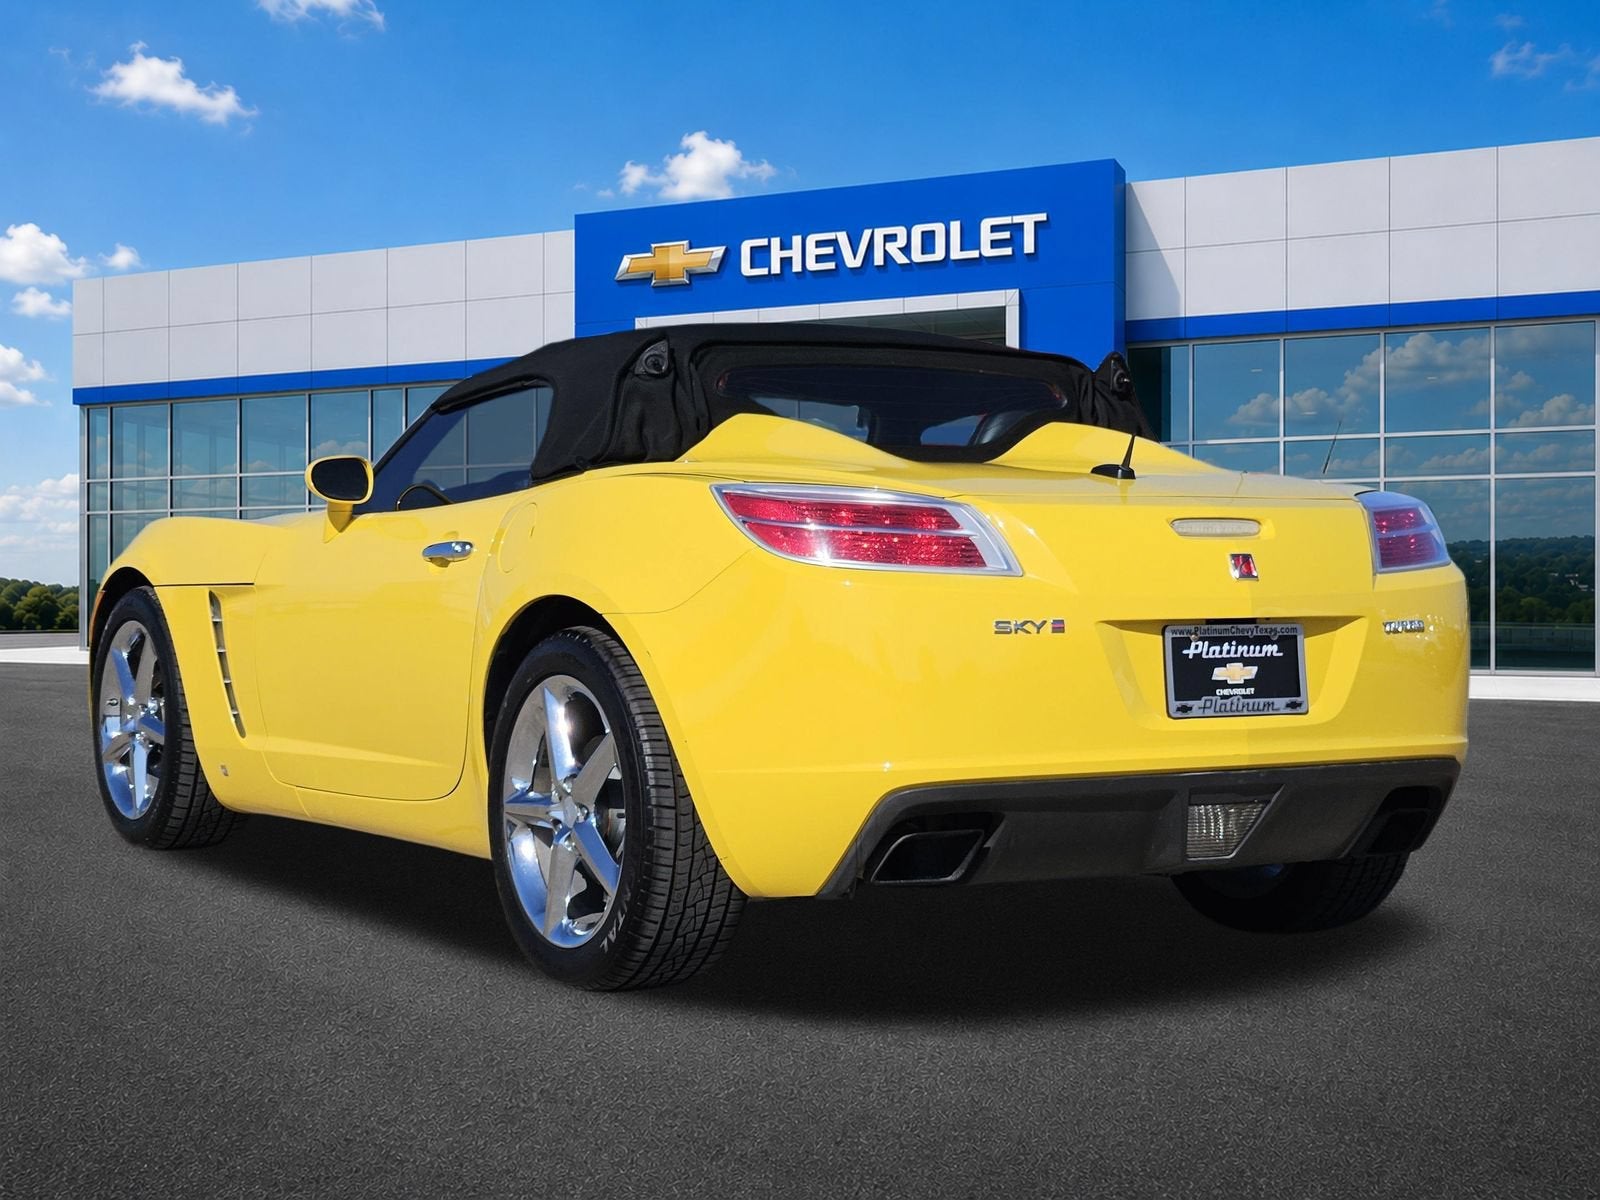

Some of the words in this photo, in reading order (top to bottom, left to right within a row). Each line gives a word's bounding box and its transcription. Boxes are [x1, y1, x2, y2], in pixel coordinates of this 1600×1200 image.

[740, 212, 1047, 277] CHEVROLET
[994, 620, 1047, 634] SKY
[1171, 625, 1298, 638] www.PlatinumChevyTexas.com
[1182, 640, 1283, 659] Platinum
[1216, 687, 1255, 696] CHEVROLET
[1198, 697, 1280, 714] Platinum
